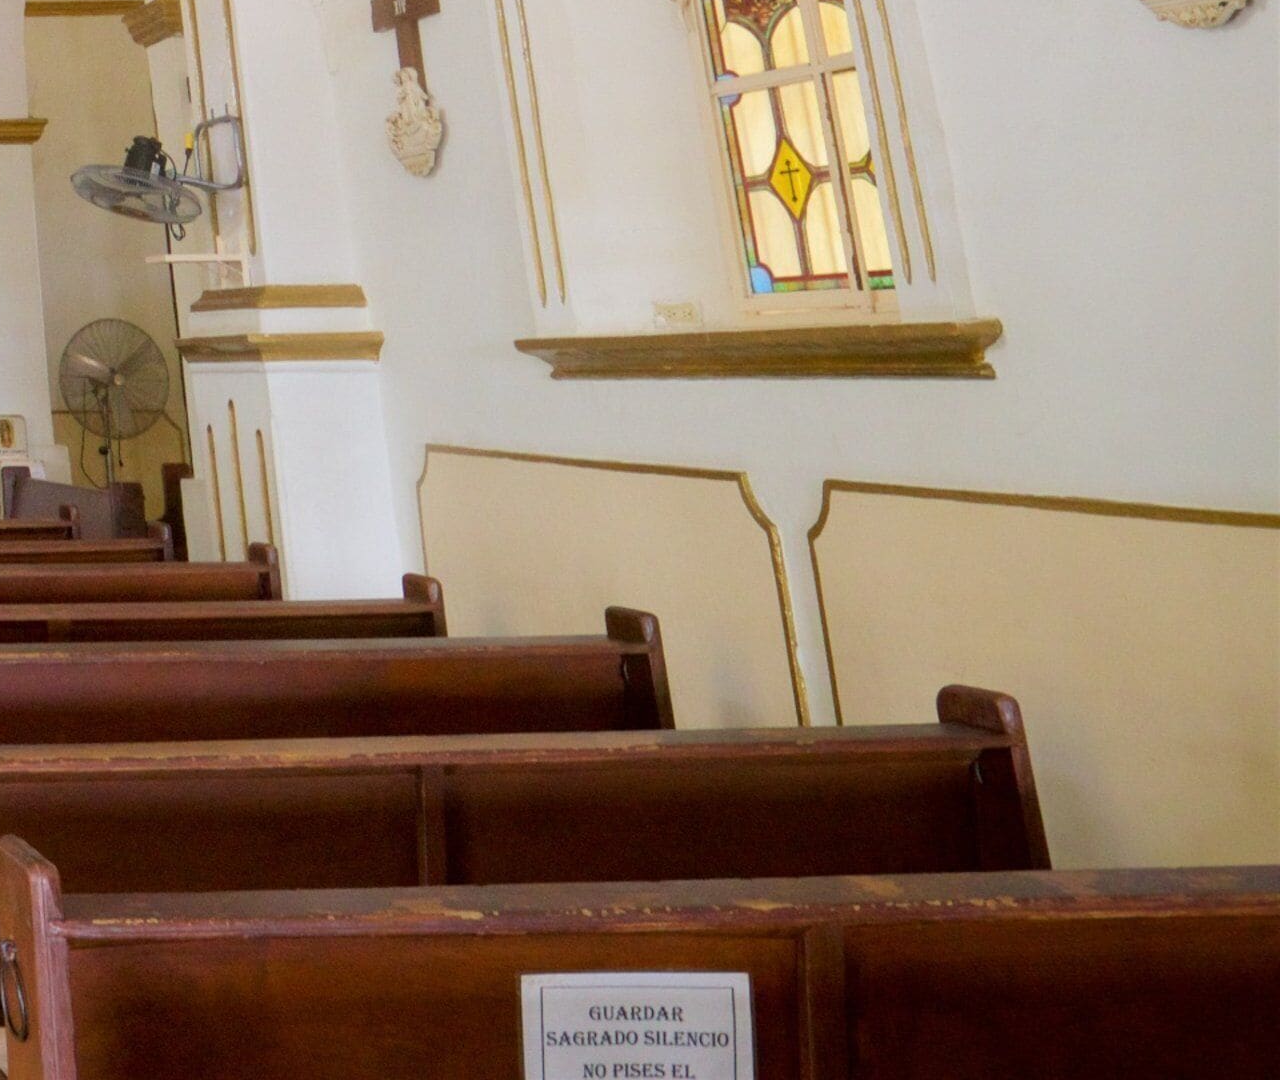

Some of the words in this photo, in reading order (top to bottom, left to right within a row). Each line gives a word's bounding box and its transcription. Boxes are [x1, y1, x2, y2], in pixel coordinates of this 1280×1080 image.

[588, 1005, 684, 1023] GUARDAR
[545, 1030, 639, 1047] SAGRADO
[643, 1030, 730, 1048] SILENCIO
[582, 1063, 608, 1080] NO
[612, 1063, 666, 1080] PISES
[671, 1063, 696, 1080] EL
